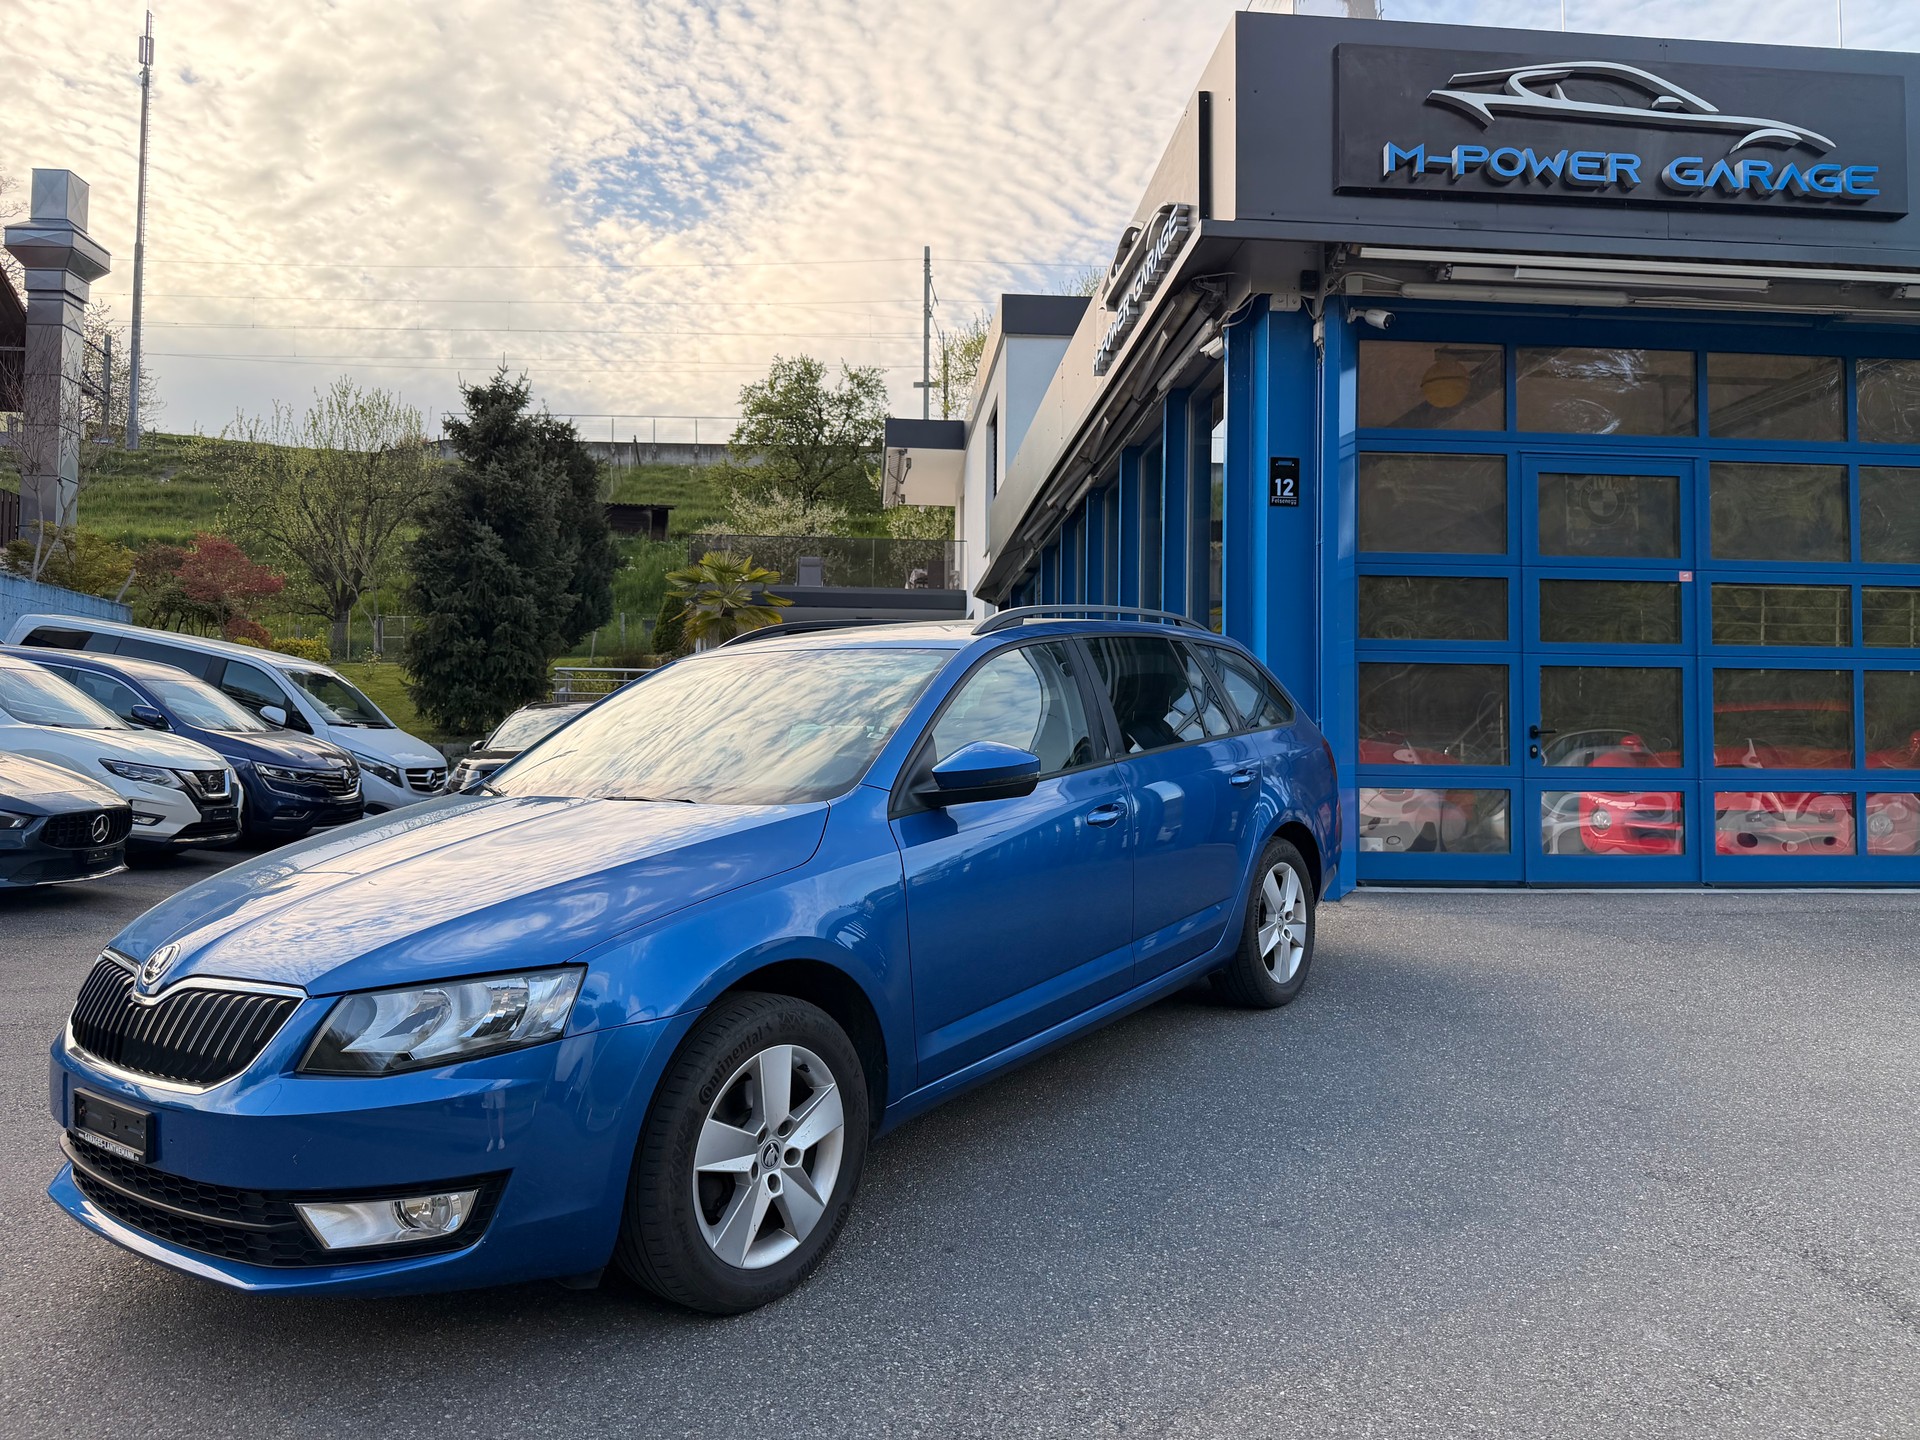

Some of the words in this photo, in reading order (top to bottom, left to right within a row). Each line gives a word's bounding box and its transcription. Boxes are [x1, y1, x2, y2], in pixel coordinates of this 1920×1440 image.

[1383, 141, 1642, 187] M-POWER
[1665, 156, 1880, 198] GARAGE
[1094, 293, 1133, 371] M-POWER
[1133, 203, 1181, 302] GARAGE
[1275, 478, 1294, 496] 12
[699, 1024, 764, 1106] Continental
